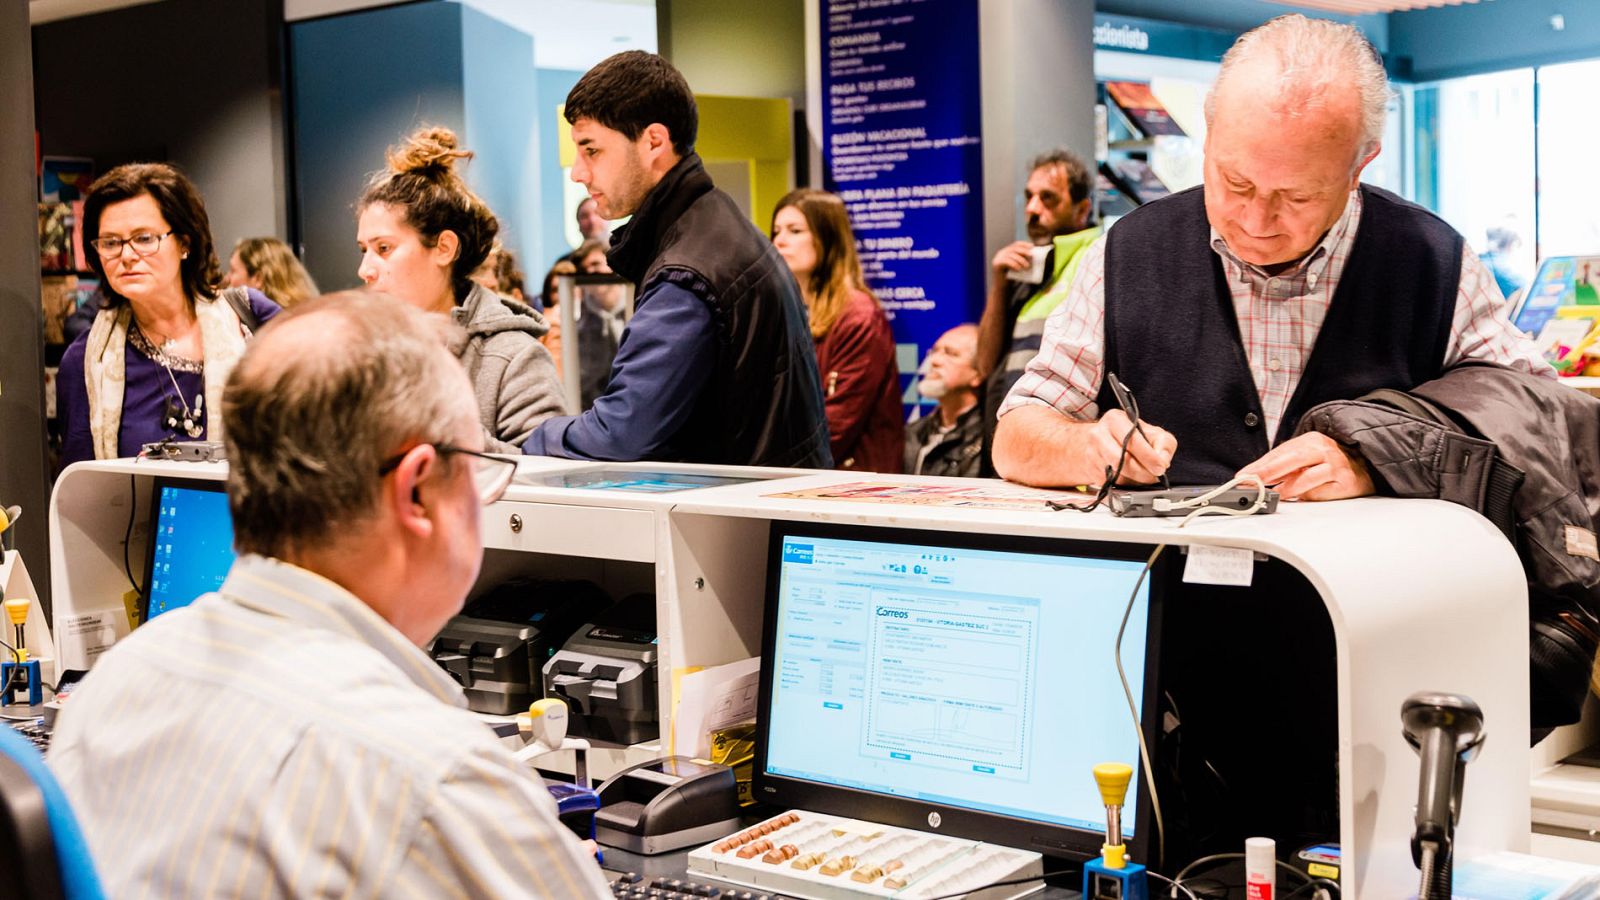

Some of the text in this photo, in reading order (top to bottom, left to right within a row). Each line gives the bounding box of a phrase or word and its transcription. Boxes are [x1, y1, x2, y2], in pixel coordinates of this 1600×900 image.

[829, 32, 881, 47] COMANDIA
[1092, 21, 1149, 51] ccionista
[883, 41, 906, 51] online
[830, 77, 915, 94] PAGA TUS RECIBOS
[831, 127, 926, 145] BUZÓN VACACIONAL
[831, 145, 875, 155] Guardamos
[886, 142, 910, 150] correo
[910, 140, 932, 149] hasta
[933, 139, 949, 148] que
[841, 181, 970, 201] RIFA PLANA EN PAQUETERÍA
[852, 204, 867, 212] que
[868, 202, 897, 210] ahorras
[908, 200, 921, 208] tus
[863, 239, 877, 250] TU
[877, 237, 913, 249] DINERO
[876, 251, 897, 261] parte
[898, 249, 911, 259] del
[911, 248, 939, 258] mundo
[895, 287, 925, 299] CERCA
[876, 607, 909, 619] Correos
[929, 812, 942, 828] hp
